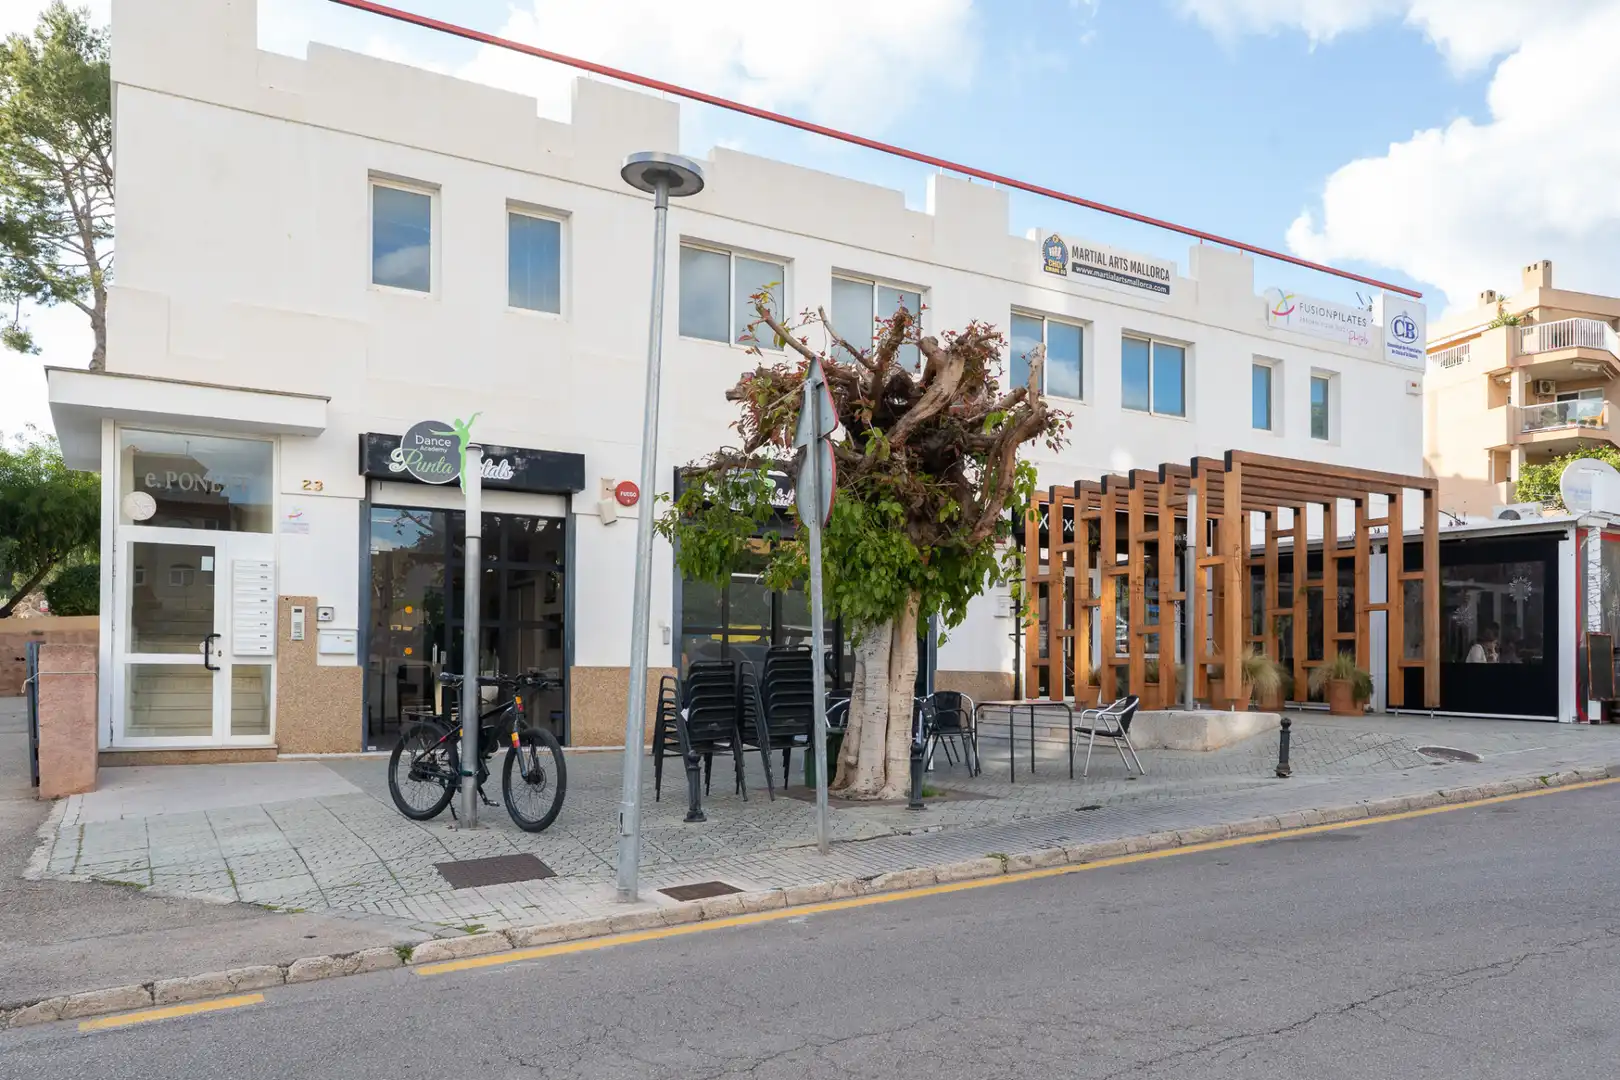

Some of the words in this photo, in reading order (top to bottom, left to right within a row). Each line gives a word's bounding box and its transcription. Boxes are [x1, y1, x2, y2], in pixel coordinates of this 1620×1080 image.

[1071, 245, 1107, 267] MARTIAL
[1109, 254, 1128, 272] ARTS
[1129, 260, 1170, 282] MALLORCA
[1075, 266, 1167, 293] www.martialartsmallorca.com
[1299, 302, 1367, 327] FUSIONPILATES
[1394, 319, 1415, 339] CB
[415, 434, 452, 447] Dance
[419, 445, 448, 453] Academy
[389, 447, 454, 474] Punta
[302, 479, 324, 492] 23
